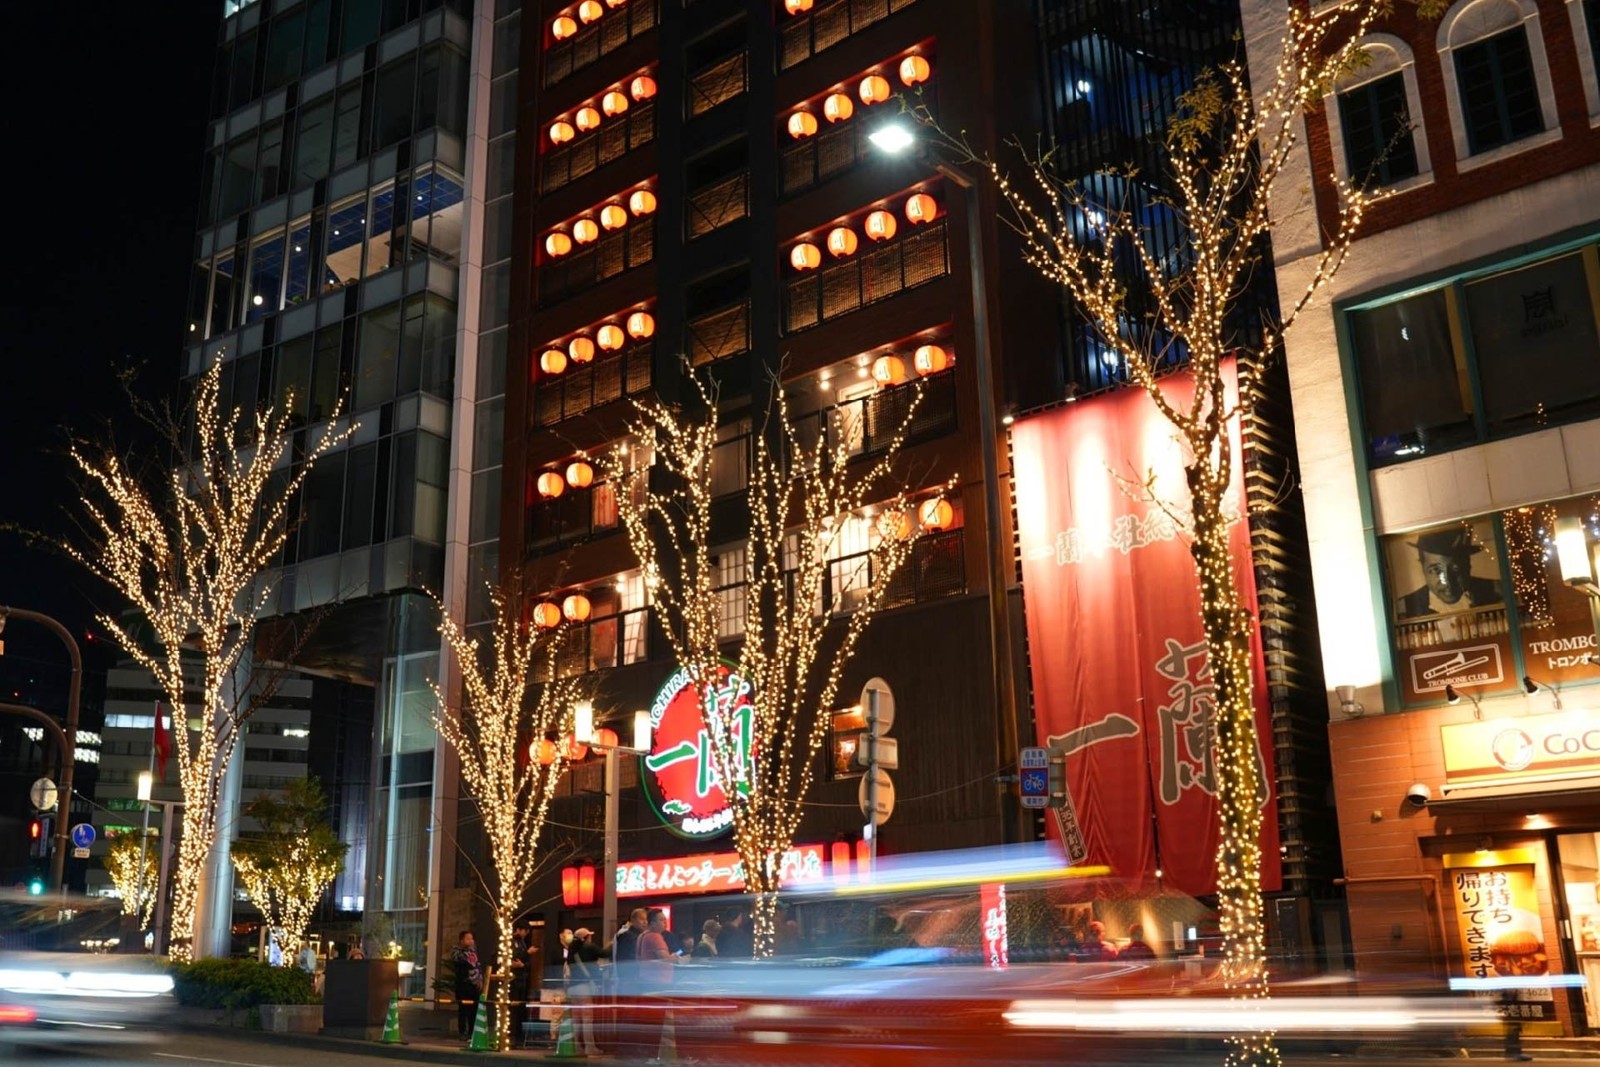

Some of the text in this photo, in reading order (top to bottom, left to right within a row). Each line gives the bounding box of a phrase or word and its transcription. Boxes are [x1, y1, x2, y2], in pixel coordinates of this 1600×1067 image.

[650, 665, 700, 727] ICHIRA
[1427, 672, 1489, 688] TROMBONE CLUB
[1456, 872, 1495, 979] 帰りできます
[1484, 871, 1513, 924] お持ち
